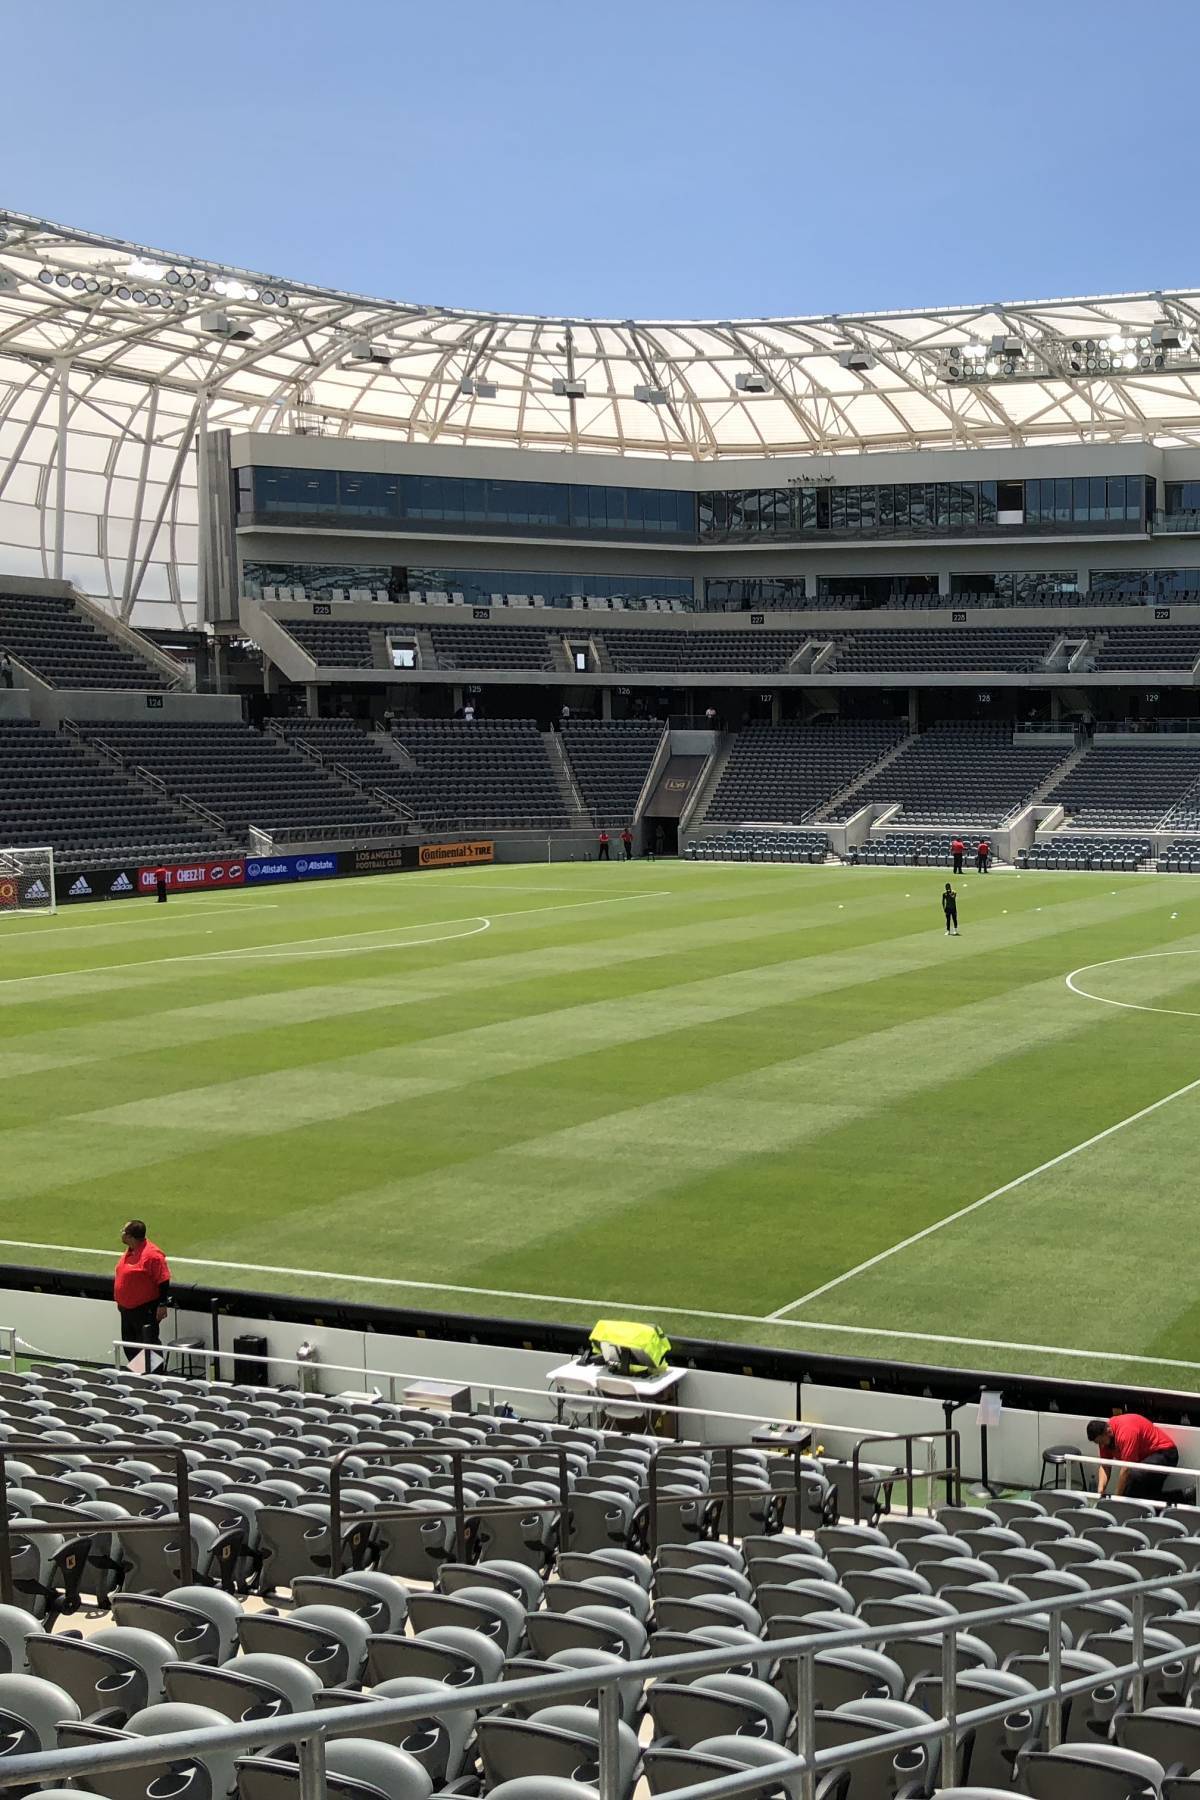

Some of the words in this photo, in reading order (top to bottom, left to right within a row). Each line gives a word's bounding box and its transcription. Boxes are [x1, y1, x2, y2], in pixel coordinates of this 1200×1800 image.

[314, 606, 330, 614] 225
[468, 685, 482, 693] 125
[618, 687, 631, 695] 126
[148, 698, 162, 706] 124
[760, 694, 773, 702] 127
[978, 694, 991, 702] 128
[1145, 694, 1159, 702] 129
[356, 851, 370, 861] LOS
[371, 849, 402, 860] ANGELES
[421, 845, 466, 863] Continental
[474, 846, 492, 856] TIRE
[355, 860, 386, 869] FOOTBALL
[387, 859, 402, 867] CLUB
[142, 871, 172, 885] CHEIT
[177, 867, 206, 882] CHEEZ-IT
